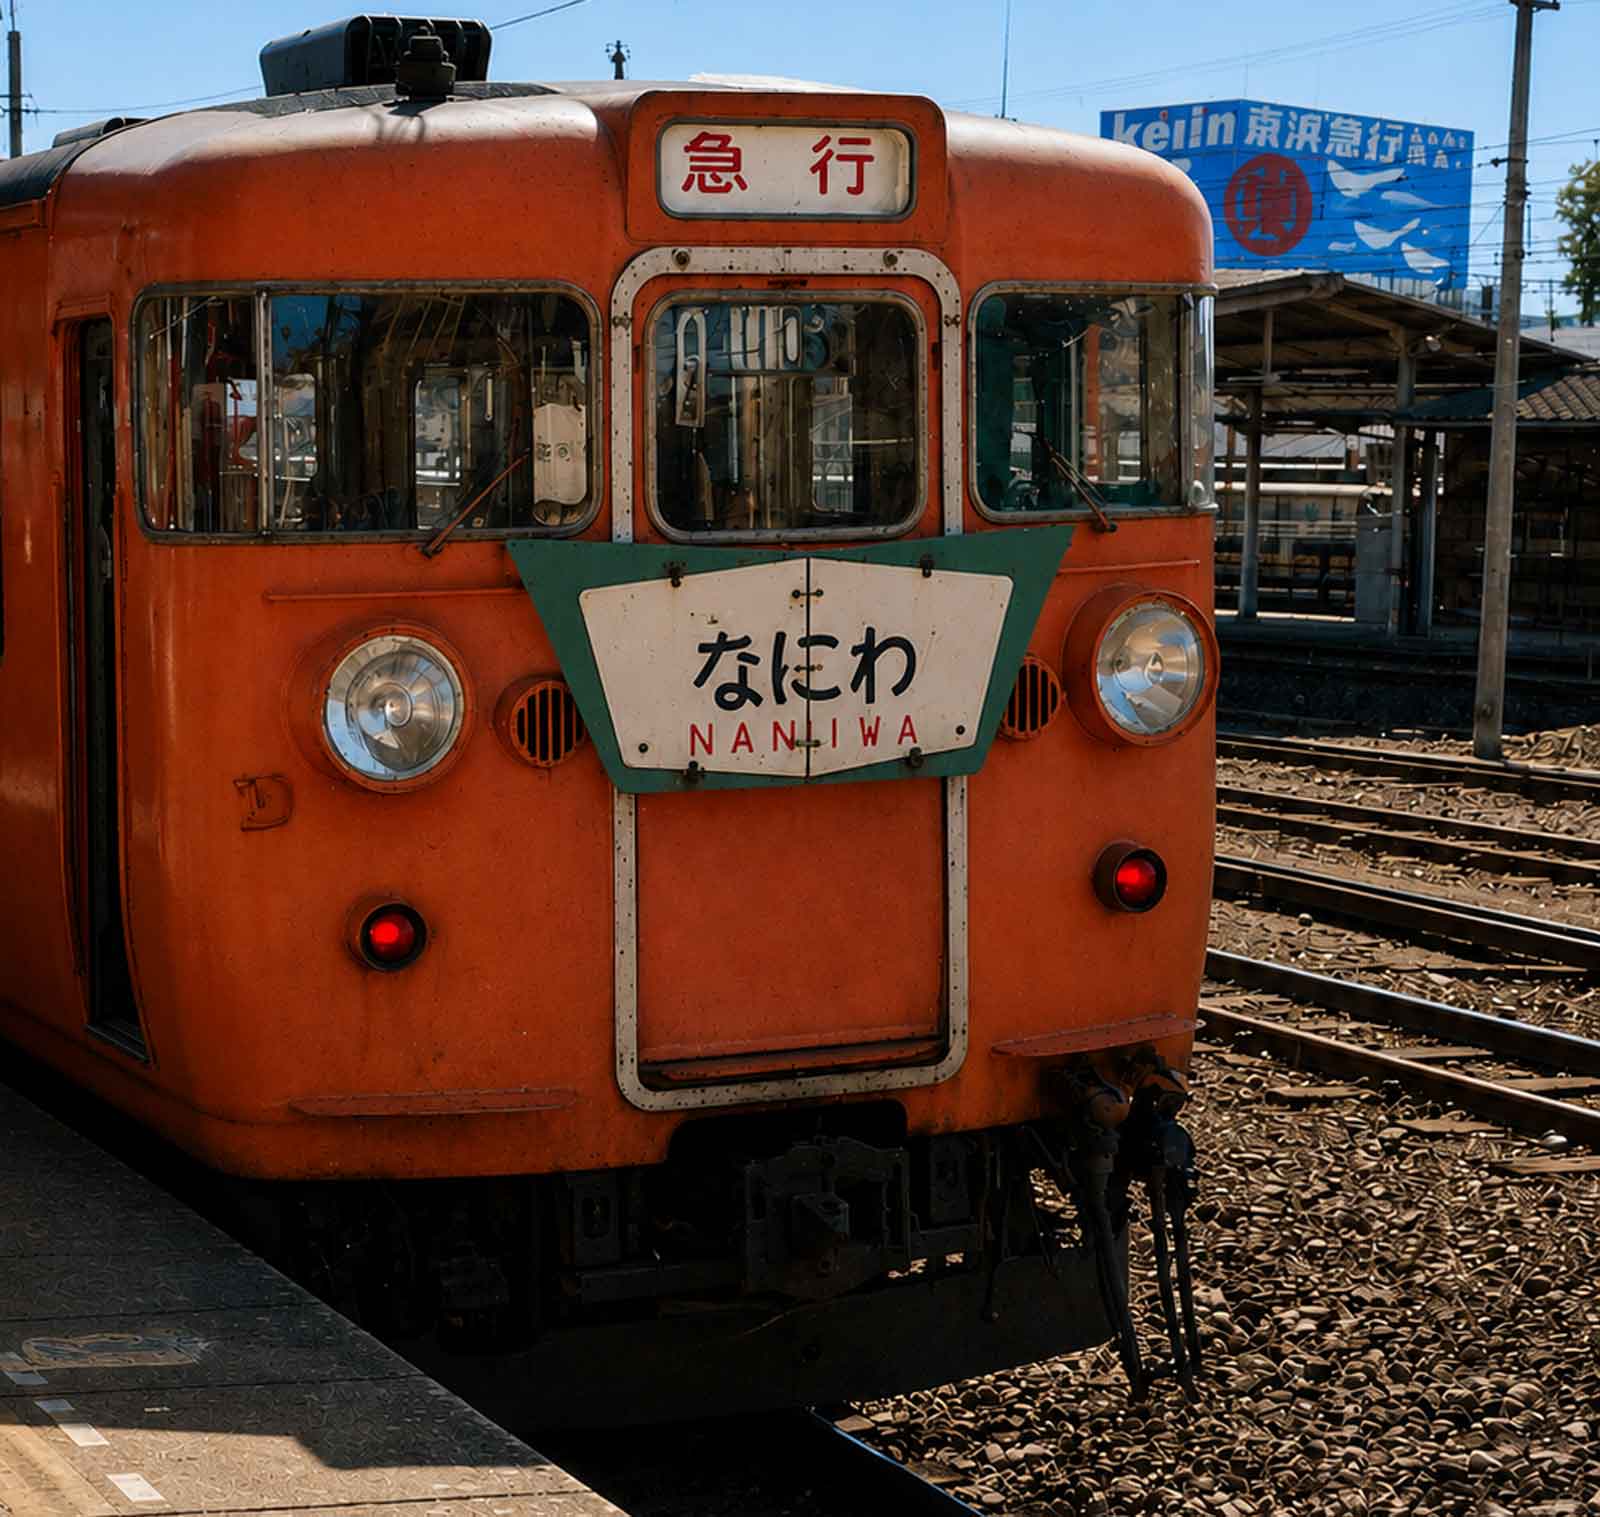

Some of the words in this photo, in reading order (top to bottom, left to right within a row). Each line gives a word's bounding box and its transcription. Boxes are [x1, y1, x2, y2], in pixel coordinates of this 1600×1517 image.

[681, 131, 875, 196] 急行
[693, 626, 917, 711] なにわ
